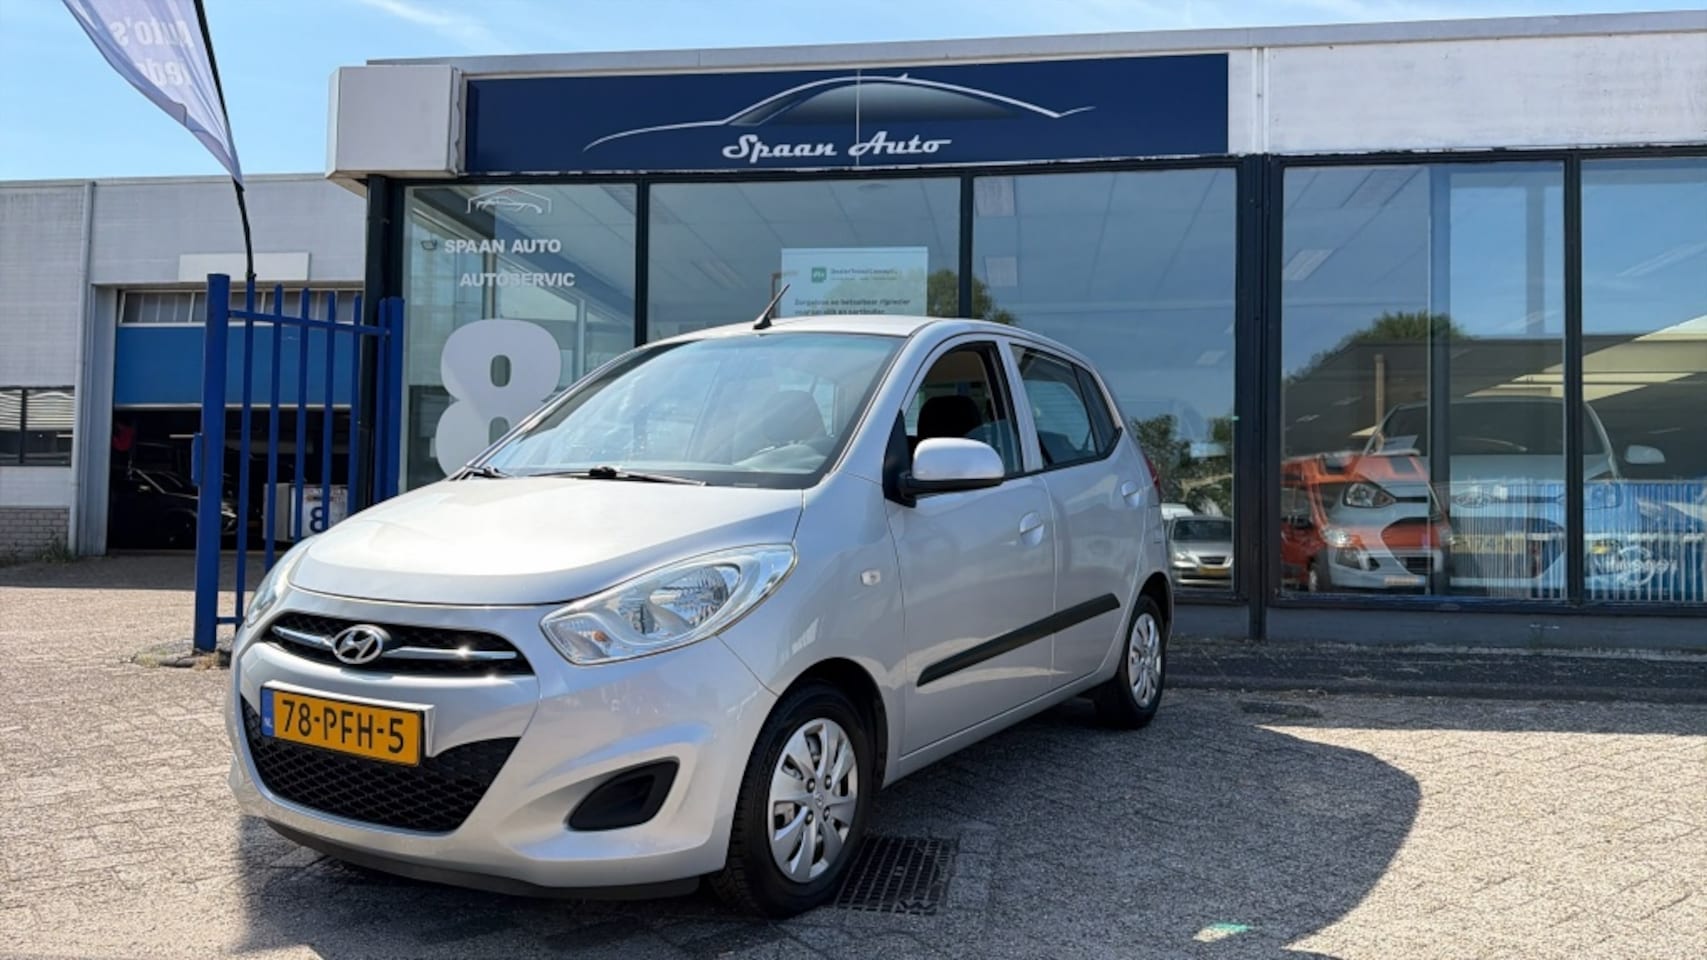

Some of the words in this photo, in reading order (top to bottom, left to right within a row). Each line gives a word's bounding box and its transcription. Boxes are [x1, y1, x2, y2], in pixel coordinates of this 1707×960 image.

[722, 133, 837, 163] Spaan
[848, 130, 952, 156] Auto
[444, 239, 505, 254] SPAAN
[511, 239, 562, 253] AUTO
[460, 272, 576, 287] AUTOSERVIC
[435, 319, 561, 478] 8
[281, 699, 404, 754] 78-PFH-5
